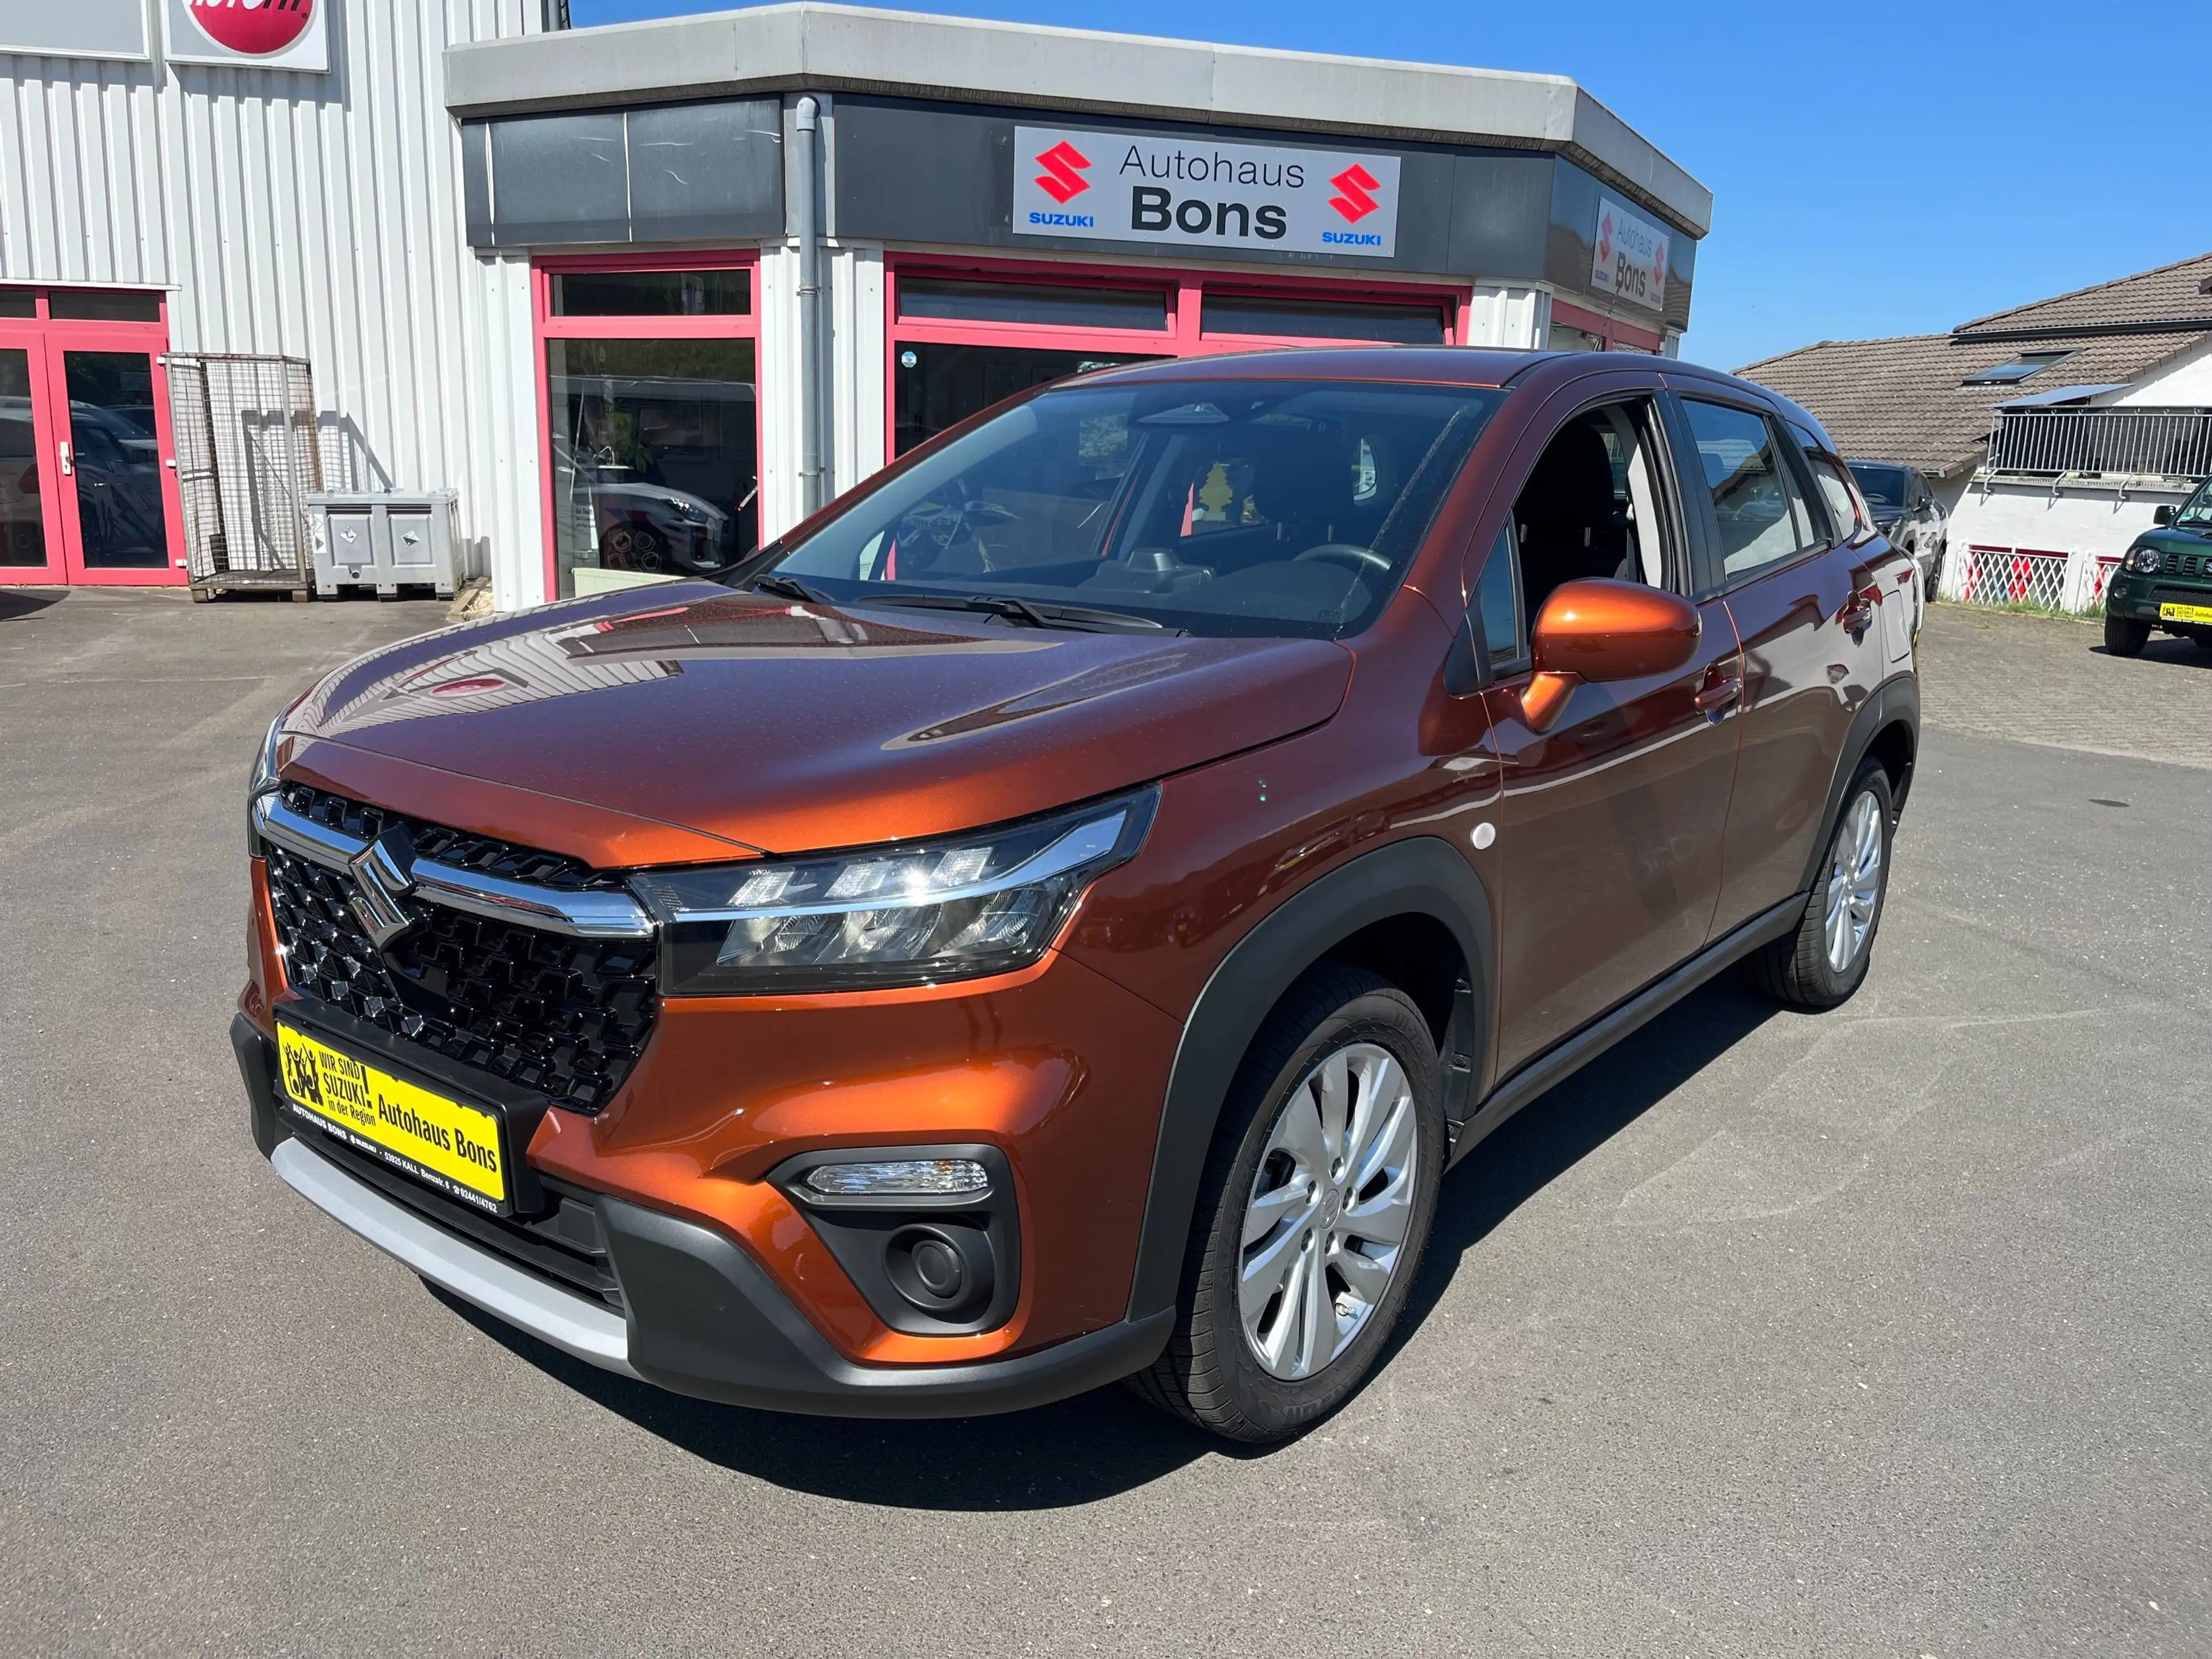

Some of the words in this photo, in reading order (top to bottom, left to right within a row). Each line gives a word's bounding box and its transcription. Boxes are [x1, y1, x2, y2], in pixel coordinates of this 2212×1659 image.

[1119, 145, 1305, 188] Autohaus
[1029, 211, 1094, 228] SUZUKI
[1131, 185, 1287, 240] Bons
[1321, 232, 1381, 247] SUZUKI
[1616, 218, 1652, 257] Autohaus
[1615, 251, 1646, 297] Bons
[319, 1051, 337, 1072] WIR
[338, 1058, 360, 1080] SIND
[327, 1096, 335, 1112] in
[336, 1100, 348, 1116] der
[350, 1104, 376, 1127] Region
[293, 1103, 327, 1129] AUTOHAUS
[327, 1122, 347, 1140] BONS
[402, 1159, 419, 1175] KALL
[378, 1093, 451, 1152] Autohaus
[454, 1127, 497, 1173] Bons
